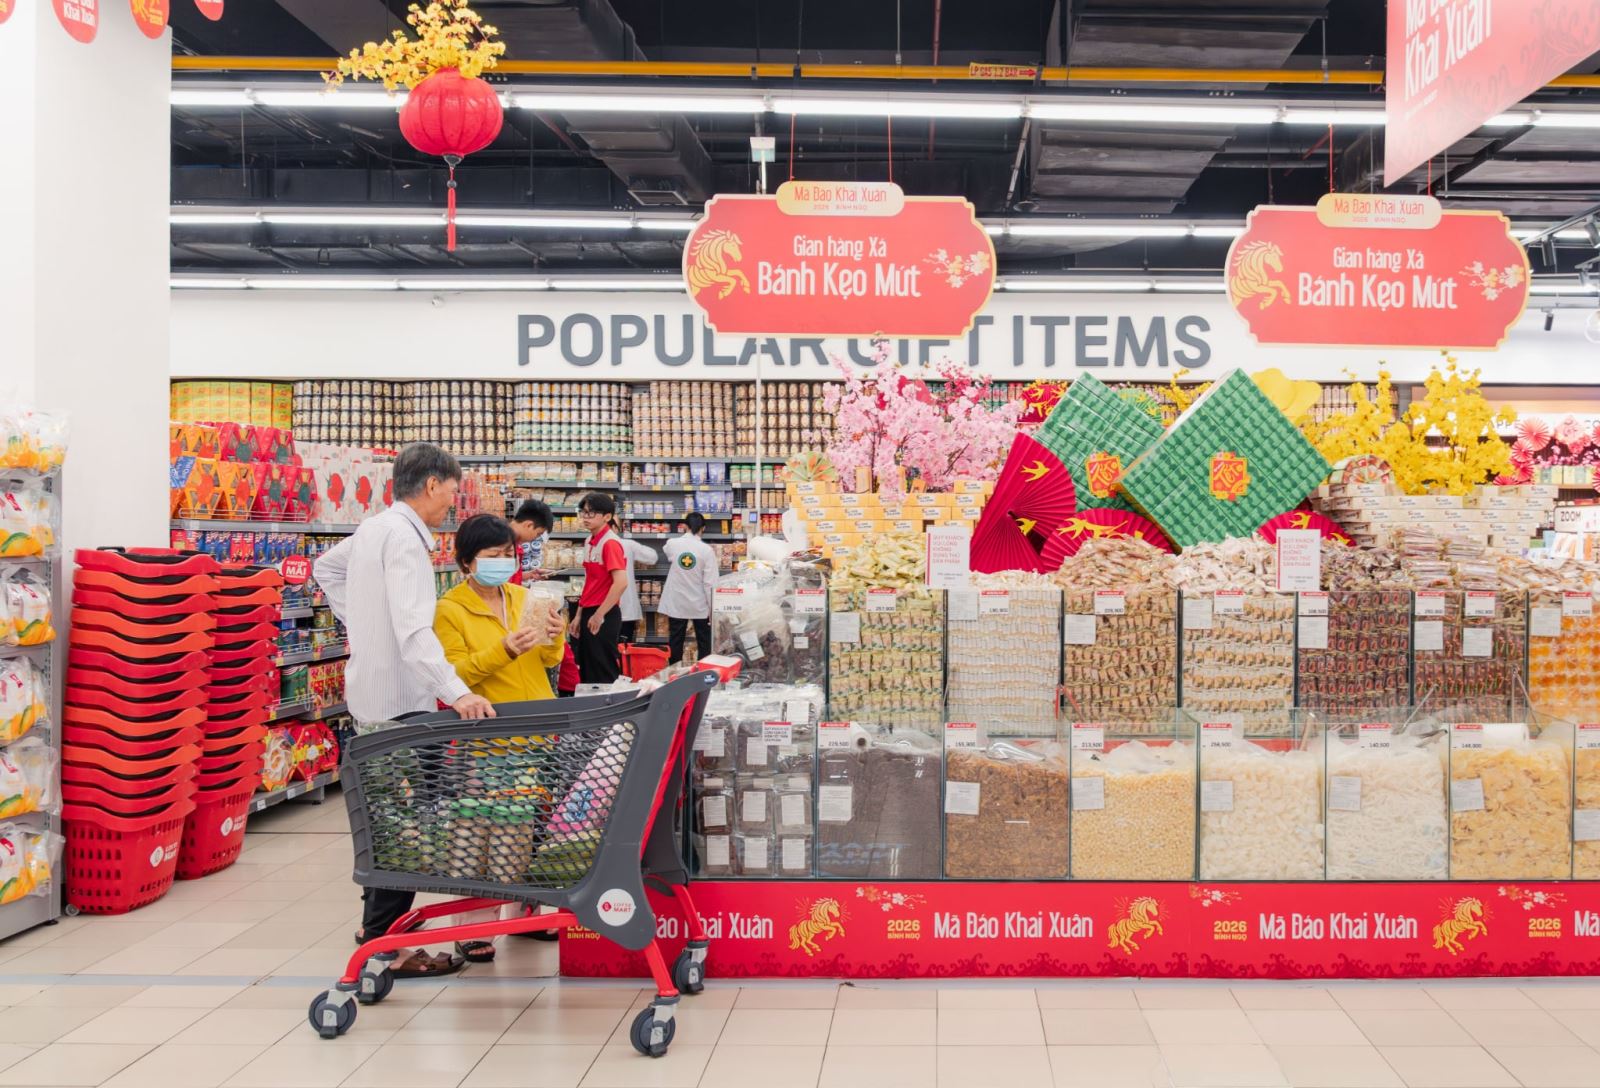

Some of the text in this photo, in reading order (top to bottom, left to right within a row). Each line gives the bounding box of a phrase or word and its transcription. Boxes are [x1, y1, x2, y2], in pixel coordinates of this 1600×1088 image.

[1405, 14, 1439, 101] Khai
[835, 186, 857, 202] Khai
[1374, 199, 1396, 215] Khai
[793, 235, 823, 256] Gian
[827, 236, 863, 261] hàng
[1333, 247, 1362, 268] Gian
[1366, 247, 1402, 273] hàng
[757, 261, 921, 300] Bánh Kẹo Mứt
[1298, 272, 1458, 312] Bánh Kẹo Mứt
[518, 312, 829, 367] POPULAR
[1013, 315, 1211, 368] ITEMS
[653, 912, 774, 939] áo hai Xuân
[887, 919, 920, 931] 2026
[933, 911, 1093, 939] Mã Đáo Khai Xuân
[1213, 920, 1247, 932] 2026
[1259, 912, 1418, 939] Mã Đáo Khai Xuân
[1528, 918, 1561, 930] 2026
